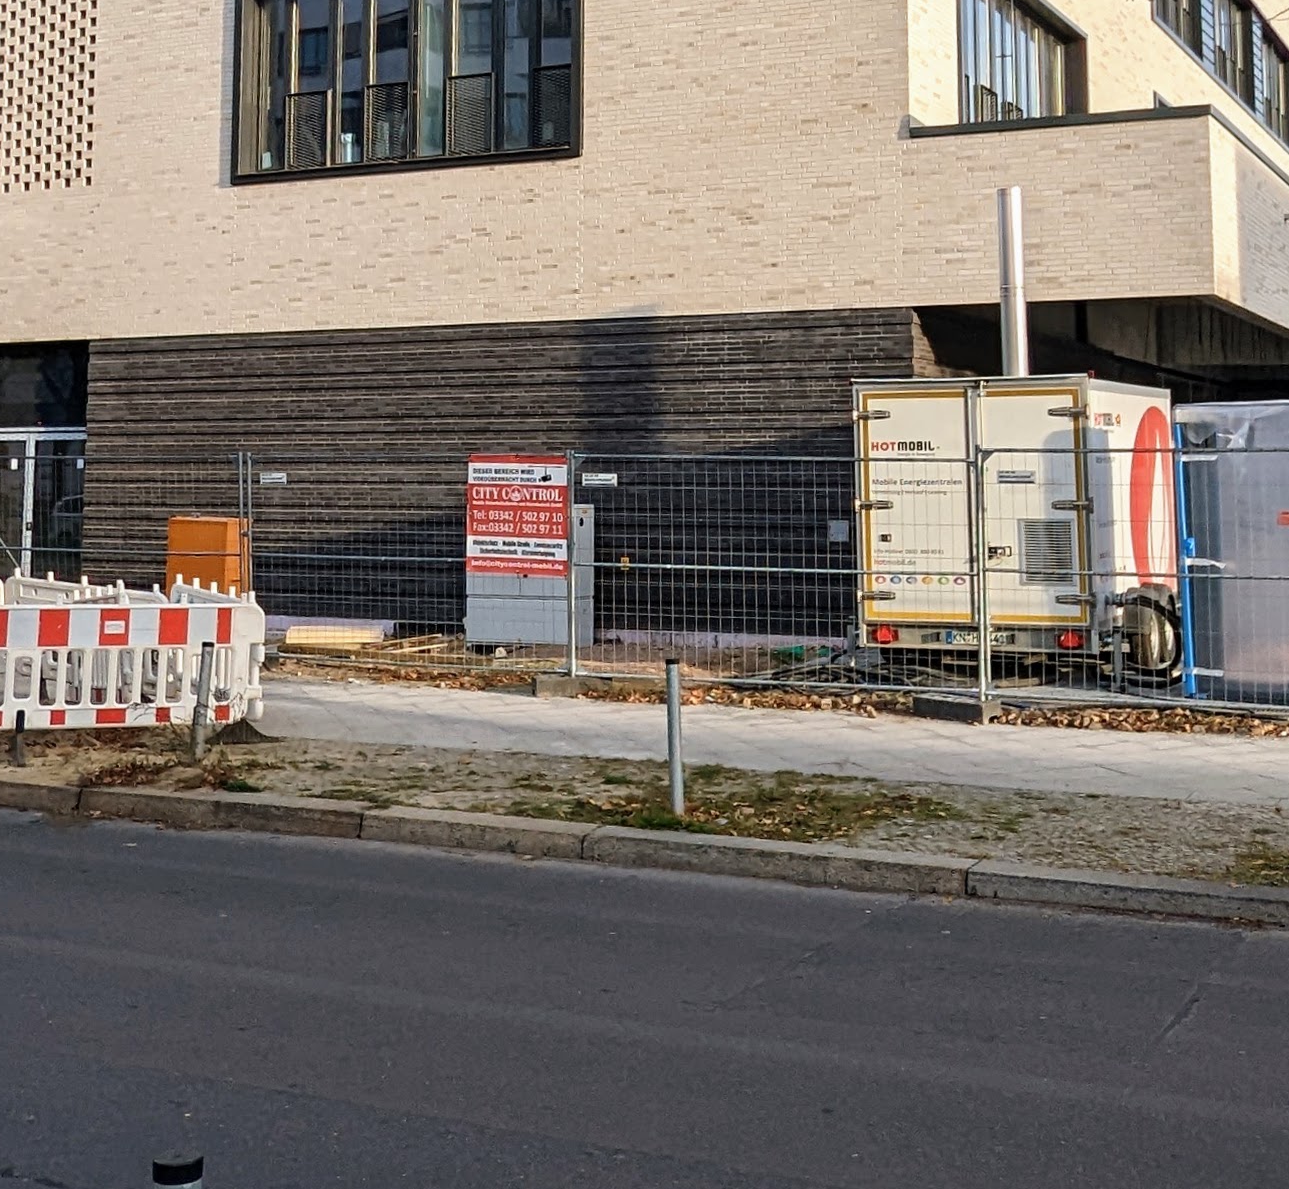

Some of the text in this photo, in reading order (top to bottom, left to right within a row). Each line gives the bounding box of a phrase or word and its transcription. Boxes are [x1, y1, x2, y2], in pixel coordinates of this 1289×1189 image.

[871, 441, 935, 451] HOTMOBIL
[899, 478, 963, 486] Energiezentralen
[472, 485, 563, 502] CITY CONTROL
[472, 510, 487, 520] Tel:
[488, 510, 514, 521] 03342
[522, 511, 538, 522] 502
[539, 512, 551, 522] 97
[552, 512, 564, 523] 10
[522, 524, 538, 534] 502
[539, 524, 551, 534] 97
[552, 525, 563, 535] 11
